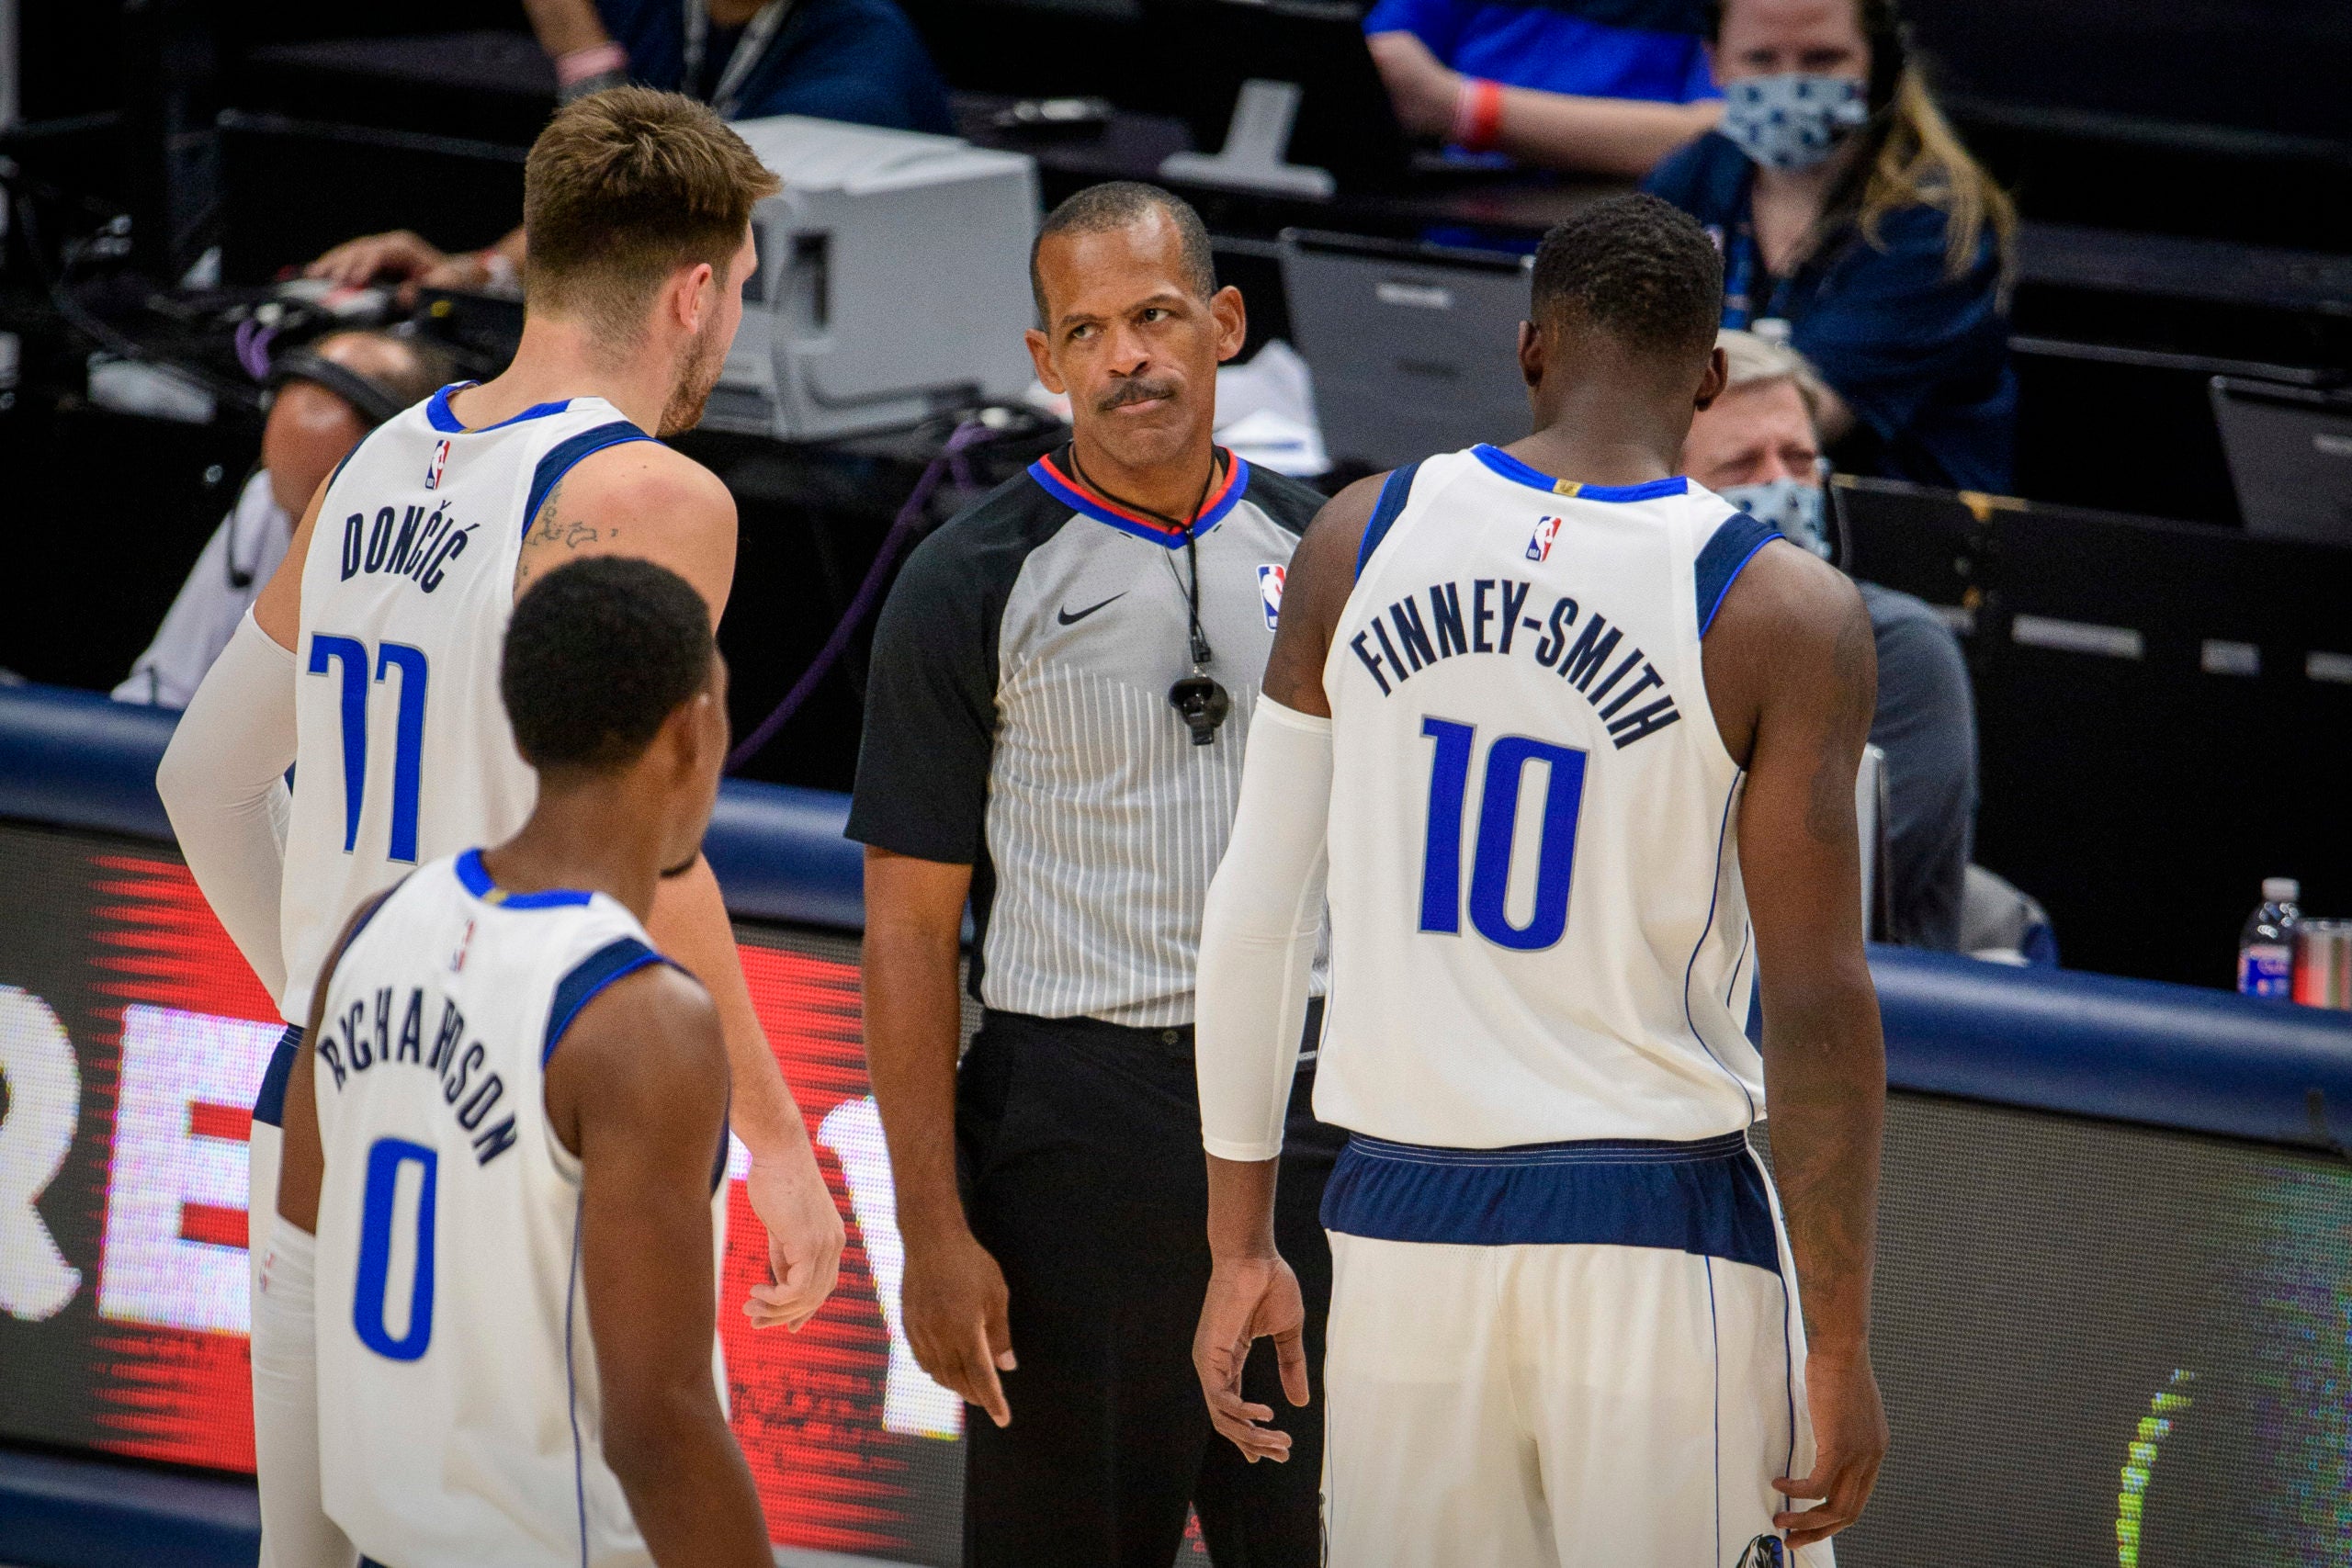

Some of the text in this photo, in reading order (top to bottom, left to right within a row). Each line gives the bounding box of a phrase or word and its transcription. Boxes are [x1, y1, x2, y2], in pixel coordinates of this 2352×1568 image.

[341, 500, 481, 593] DONČIĆ
[306, 631, 429, 865] 77
[1350, 579, 1681, 750] FINNEY-SMITH
[1416, 714, 1590, 953] 10
[352, 1136, 438, 1363] 0
